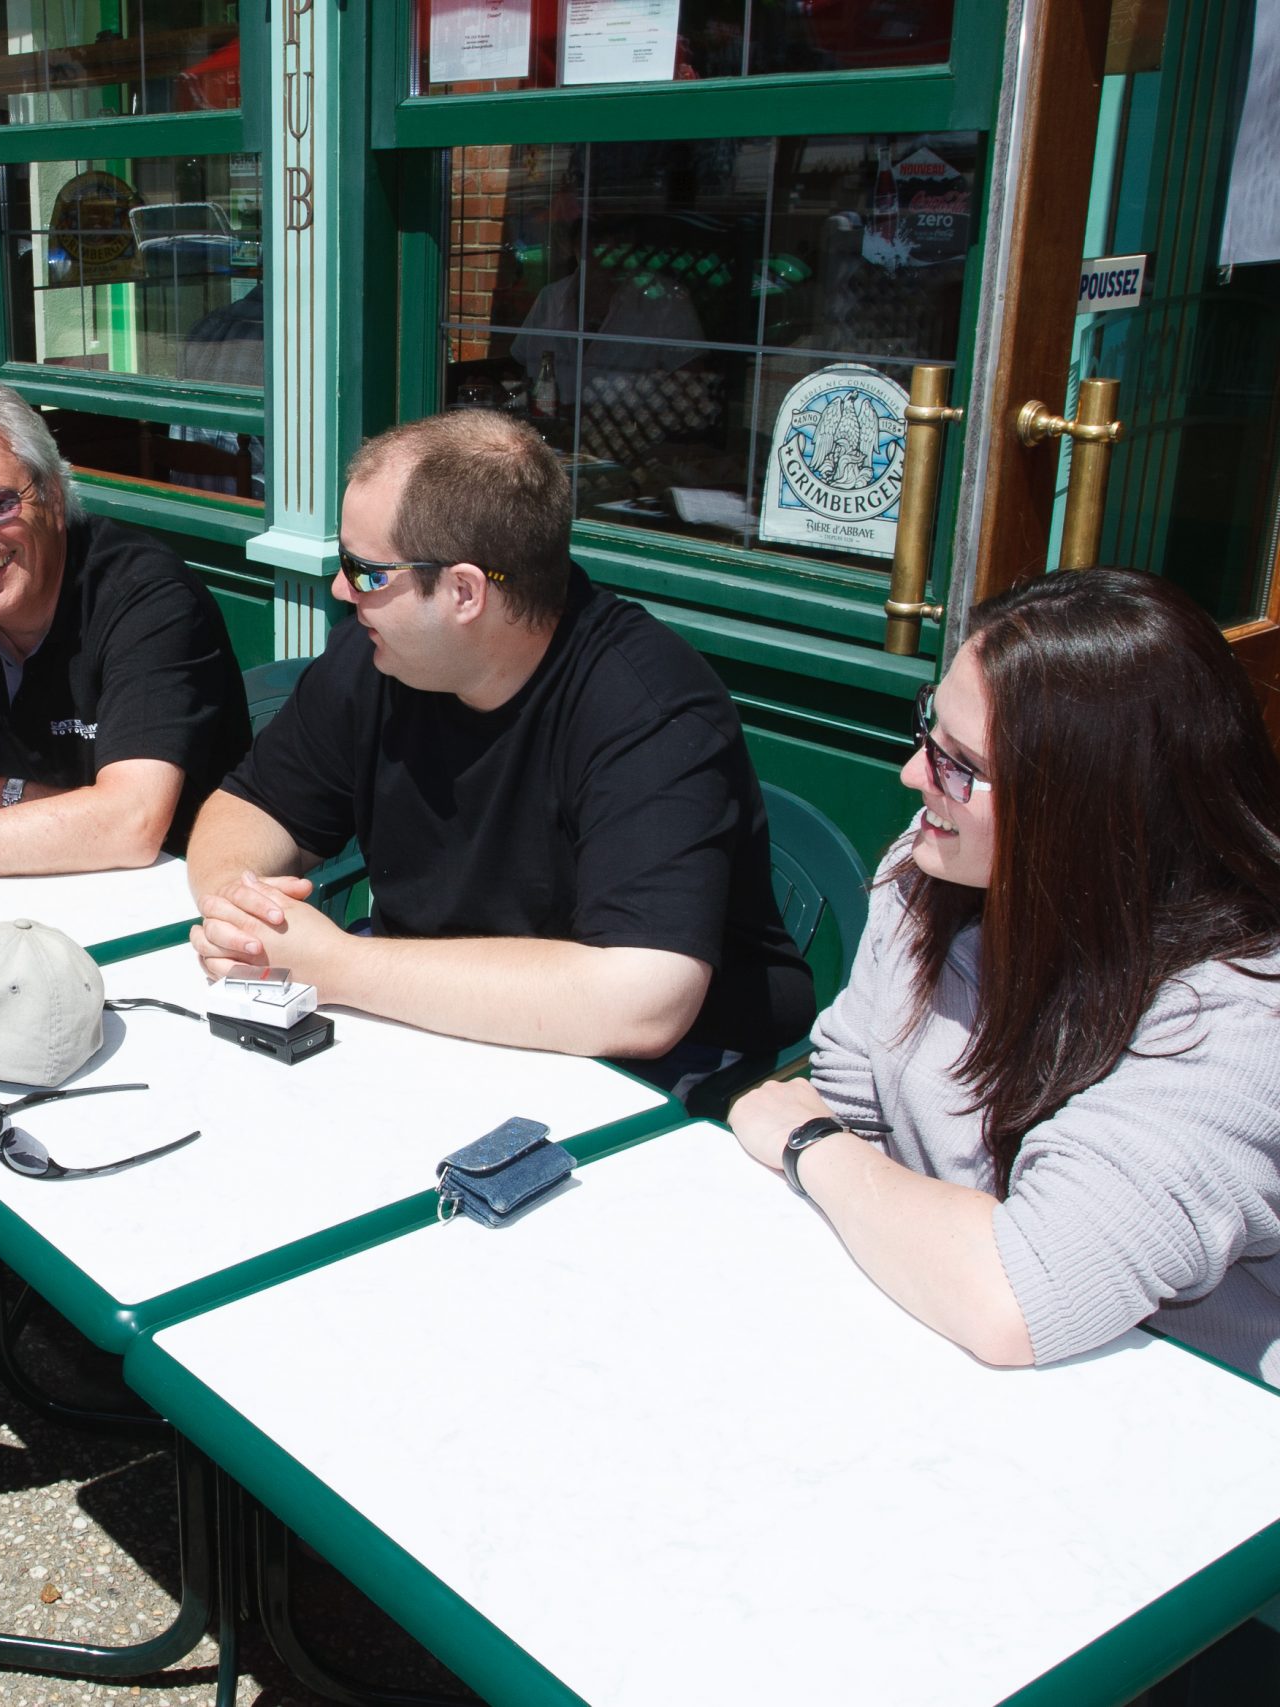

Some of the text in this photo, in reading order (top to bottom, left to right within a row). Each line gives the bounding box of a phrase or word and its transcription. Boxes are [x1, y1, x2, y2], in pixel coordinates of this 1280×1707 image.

[283, 0, 314, 231] PUB
[916, 213, 954, 228] zero
[1078, 268, 1140, 301] POUSSEZ
[796, 414, 897, 432] ANNO 1128
[786, 460, 904, 514] GRIMBERGEN
